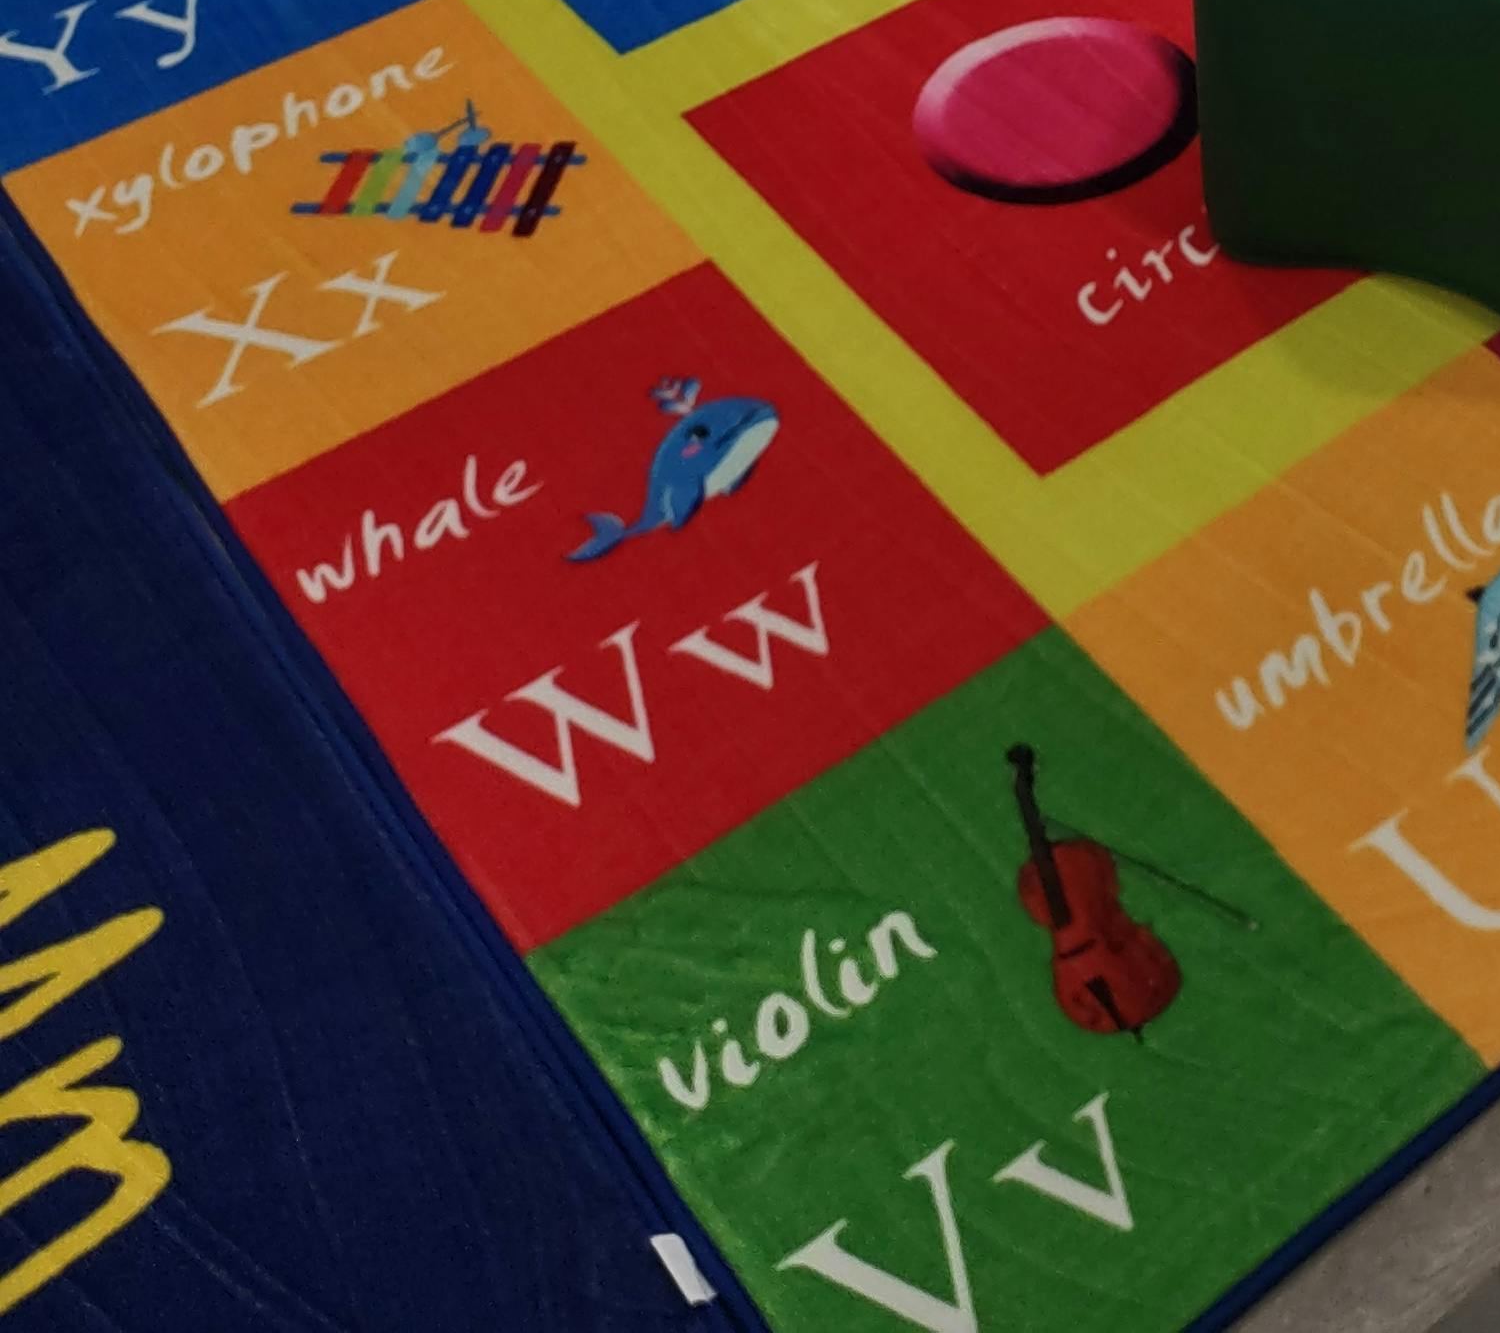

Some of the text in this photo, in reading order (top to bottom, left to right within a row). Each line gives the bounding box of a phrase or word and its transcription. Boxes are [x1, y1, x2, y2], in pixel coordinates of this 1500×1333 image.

[65, 45, 453, 237] xylophone
[153, 252, 446, 408] Xx
[297, 456, 537, 602] whale
[435, 564, 828, 806] Ww
[658, 912, 937, 1110] violin
[777, 1093, 1135, 1333] Vv
